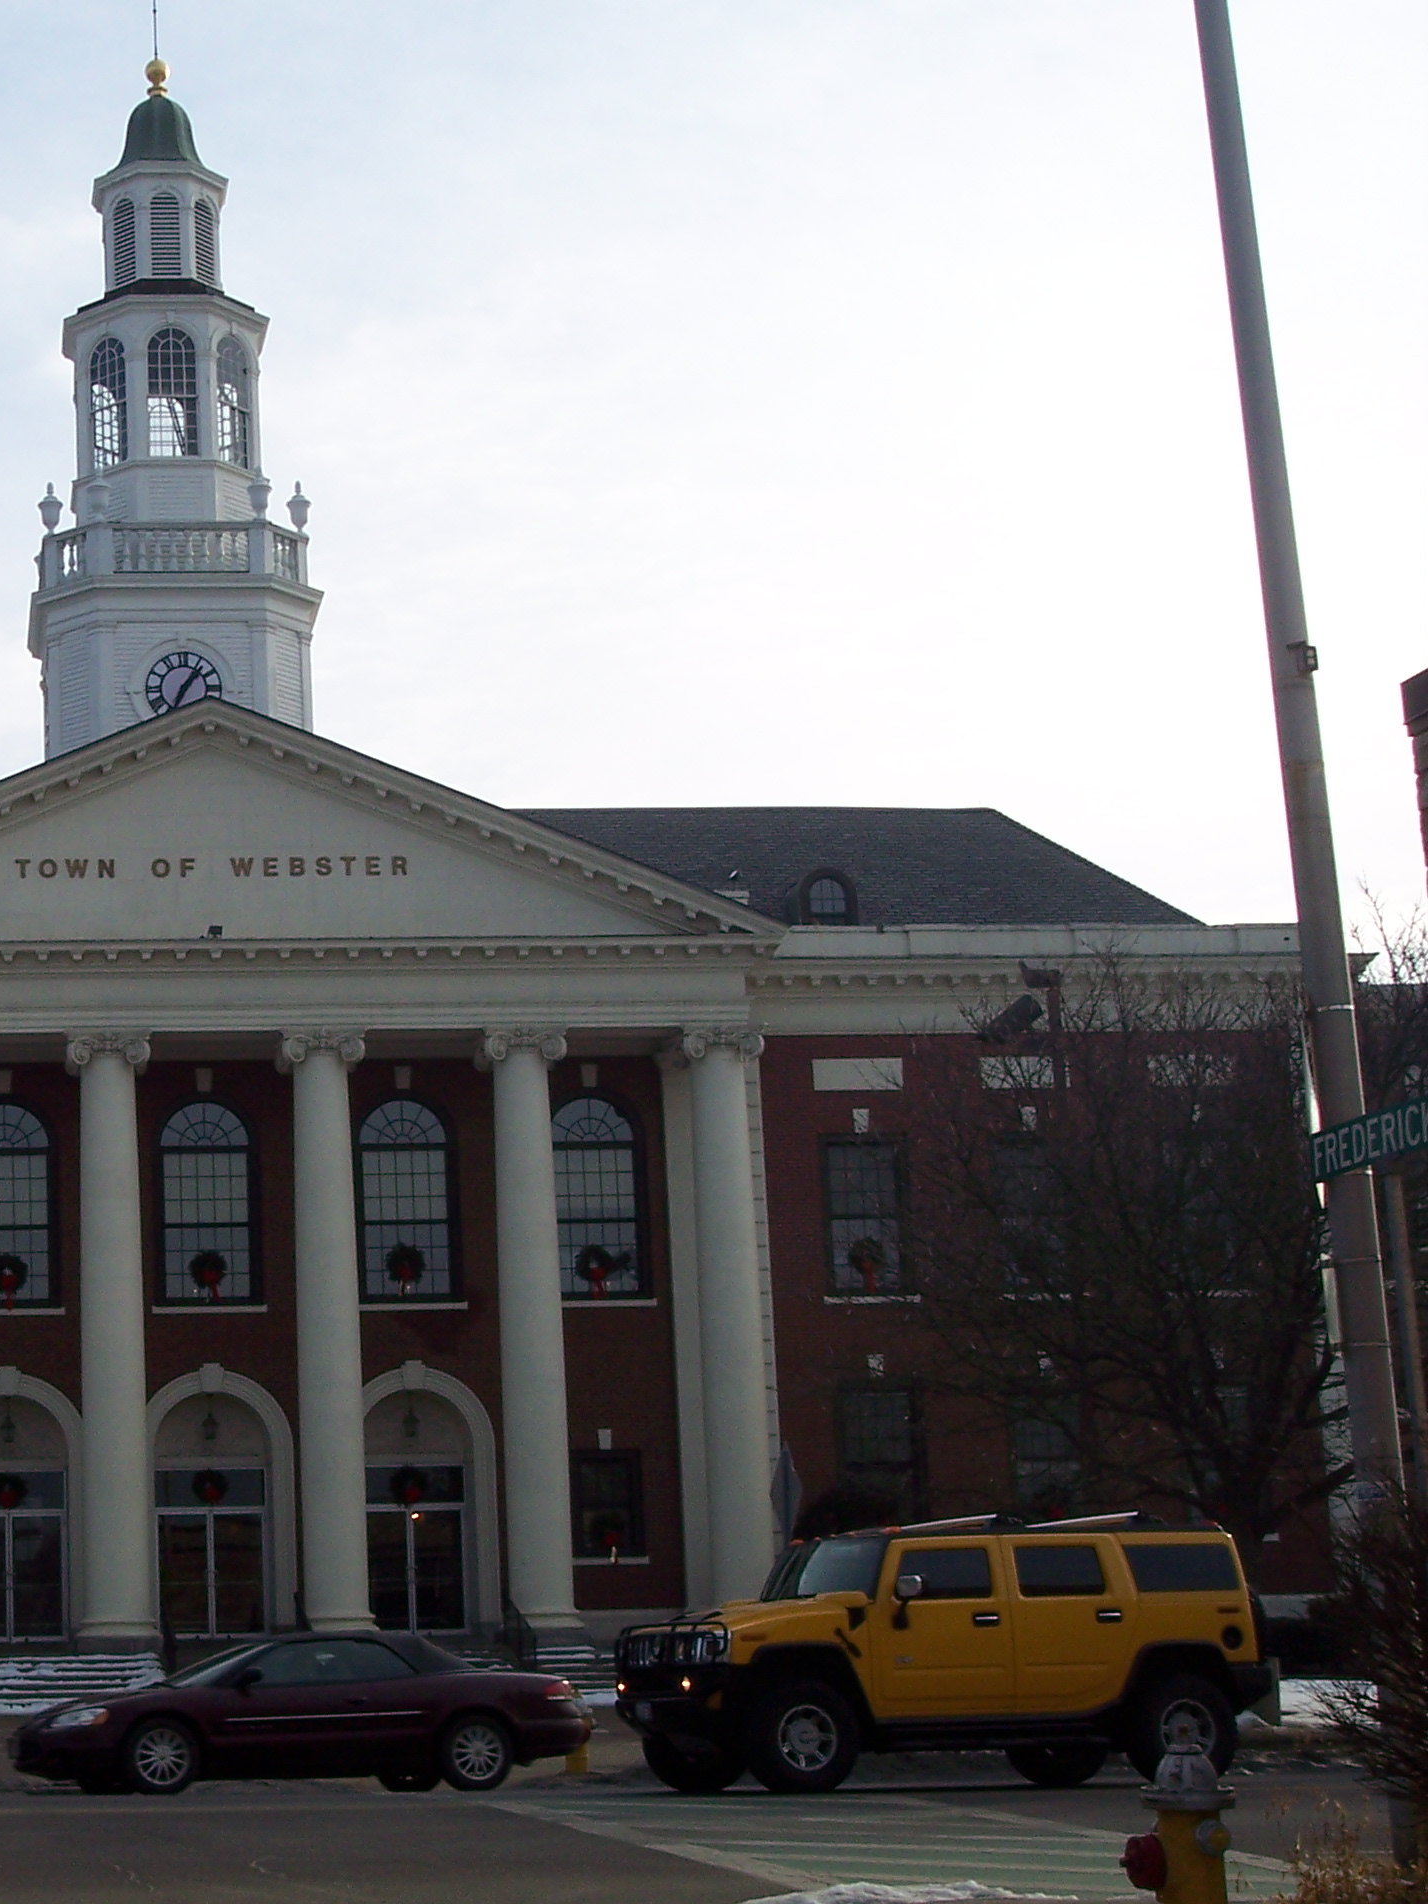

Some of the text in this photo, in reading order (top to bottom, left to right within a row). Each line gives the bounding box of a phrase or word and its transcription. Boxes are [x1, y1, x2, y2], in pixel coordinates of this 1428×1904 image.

[15, 855, 409, 879] TOWN OF WEBSTER
